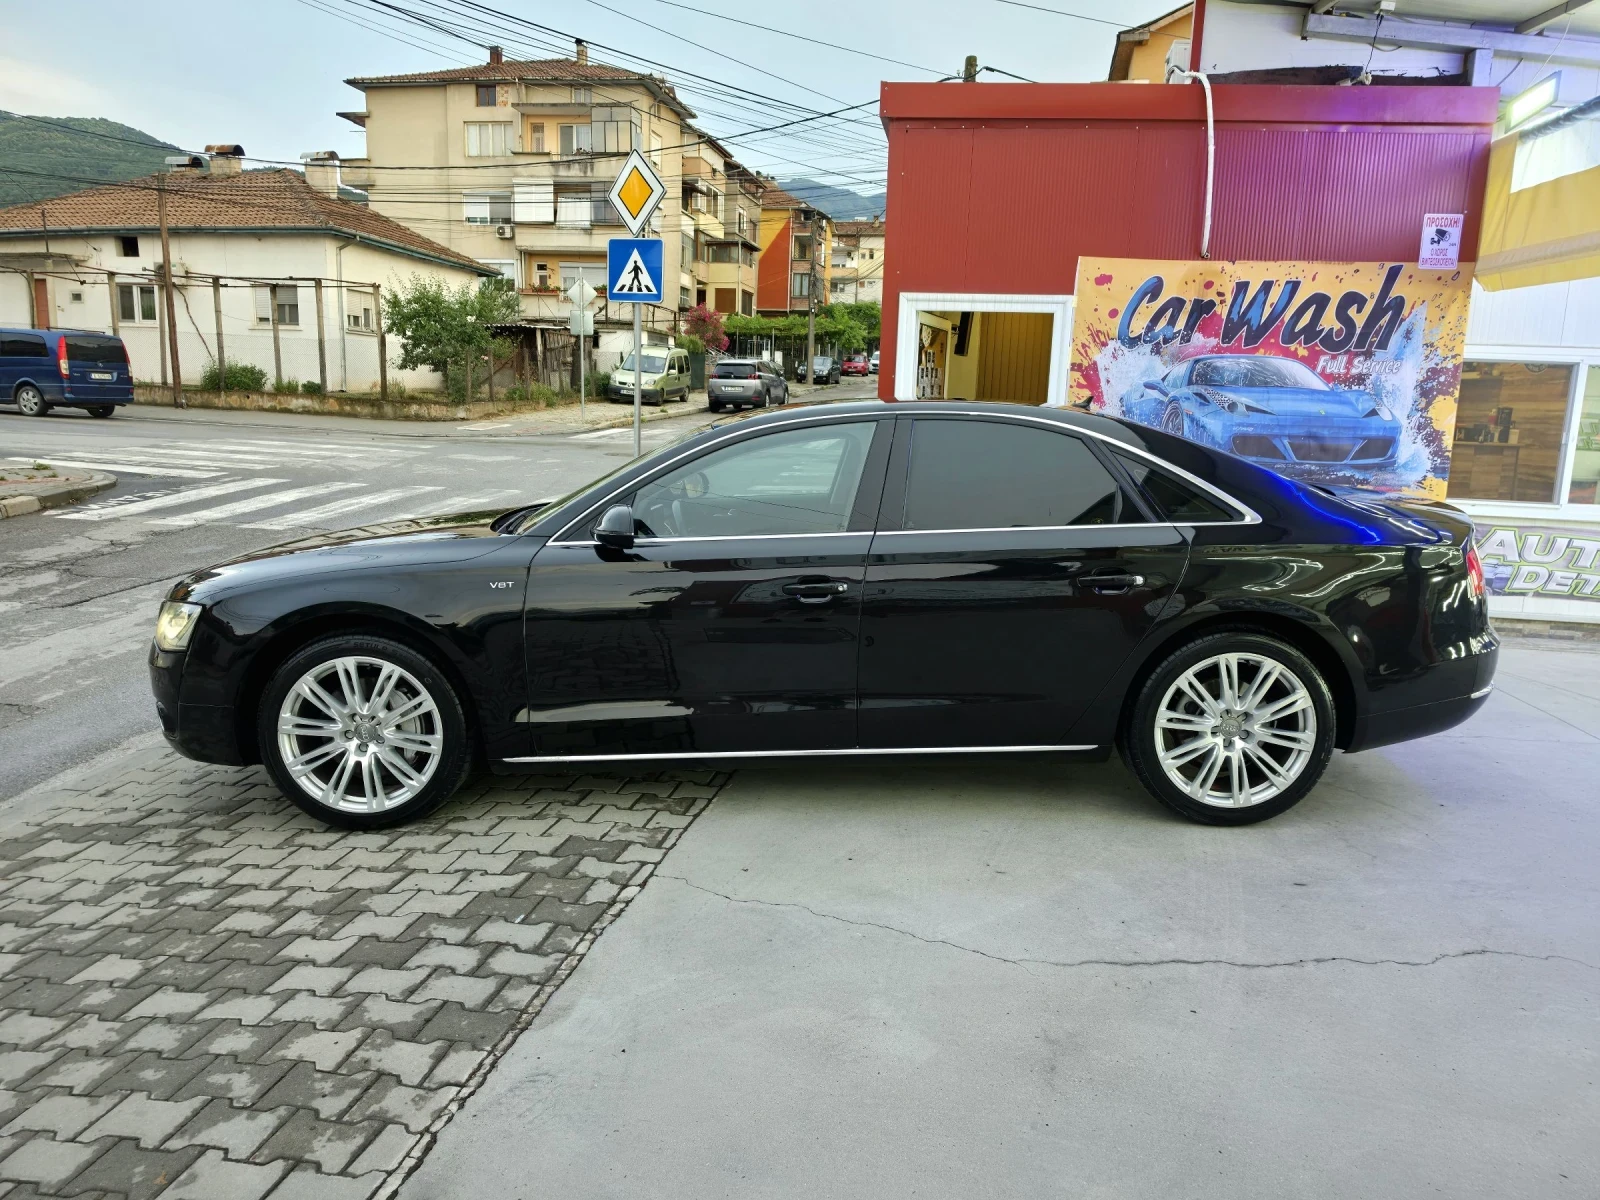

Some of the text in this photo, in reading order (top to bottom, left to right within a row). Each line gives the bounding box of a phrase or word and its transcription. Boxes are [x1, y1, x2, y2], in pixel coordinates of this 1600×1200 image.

[1426, 216, 1460, 228] ΠΡΟΣΟΧΗ!
[1117, 264, 1406, 354] Car Wash
[1316, 354, 1401, 375] Full Service
[489, 581, 515, 589] V8T
[1507, 564, 1600, 597] DET
